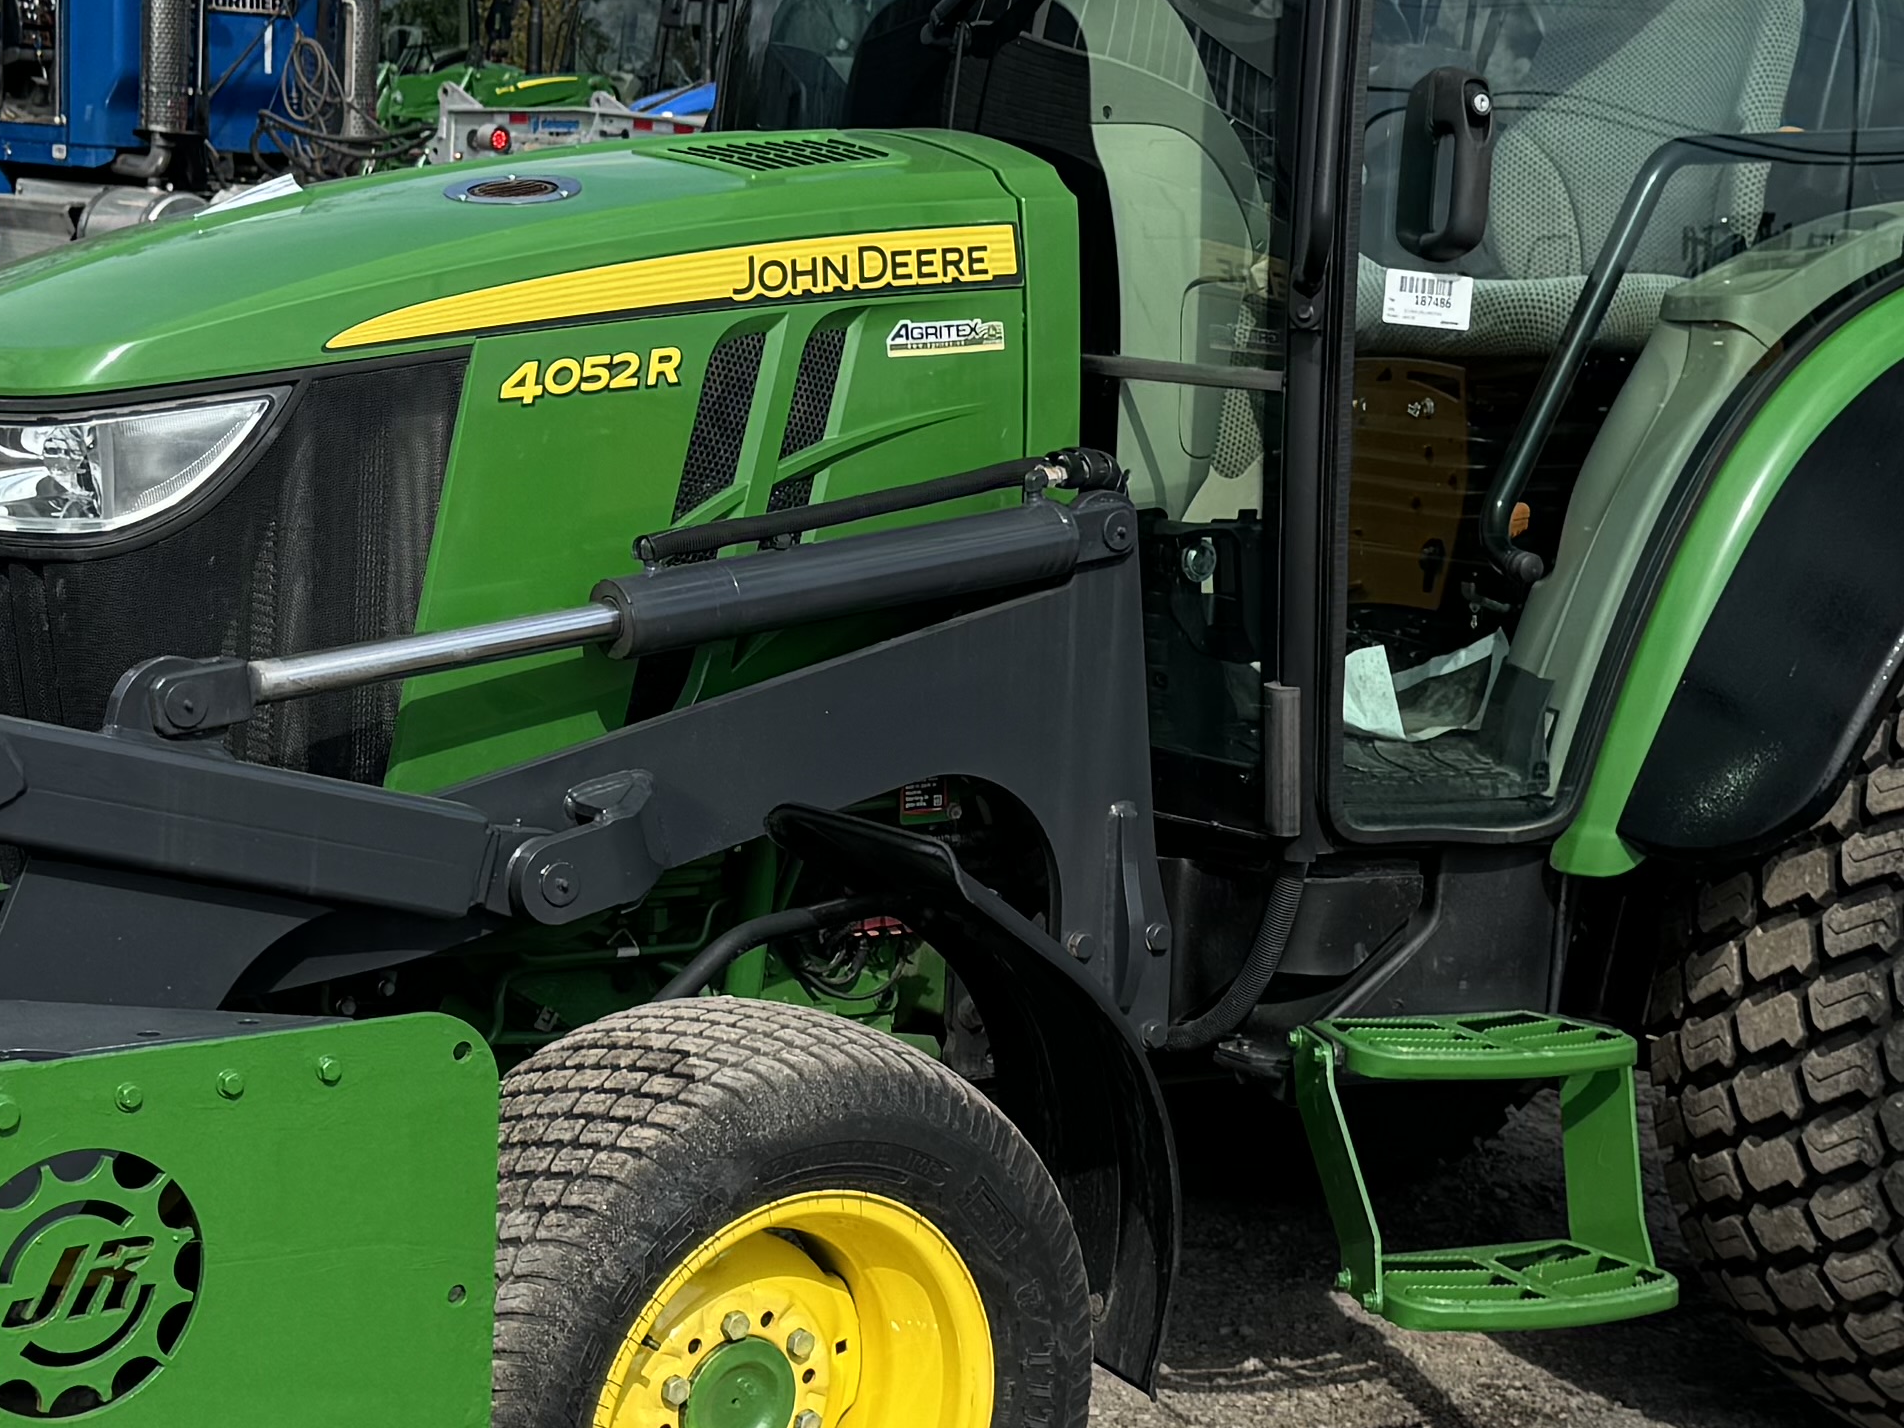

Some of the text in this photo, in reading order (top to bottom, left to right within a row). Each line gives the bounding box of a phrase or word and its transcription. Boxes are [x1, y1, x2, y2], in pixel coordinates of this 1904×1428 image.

[733, 245, 989, 295] JOHN DEERE
[890, 323, 981, 342] AGRITEX
[0, 1235, 155, 1330] JR
